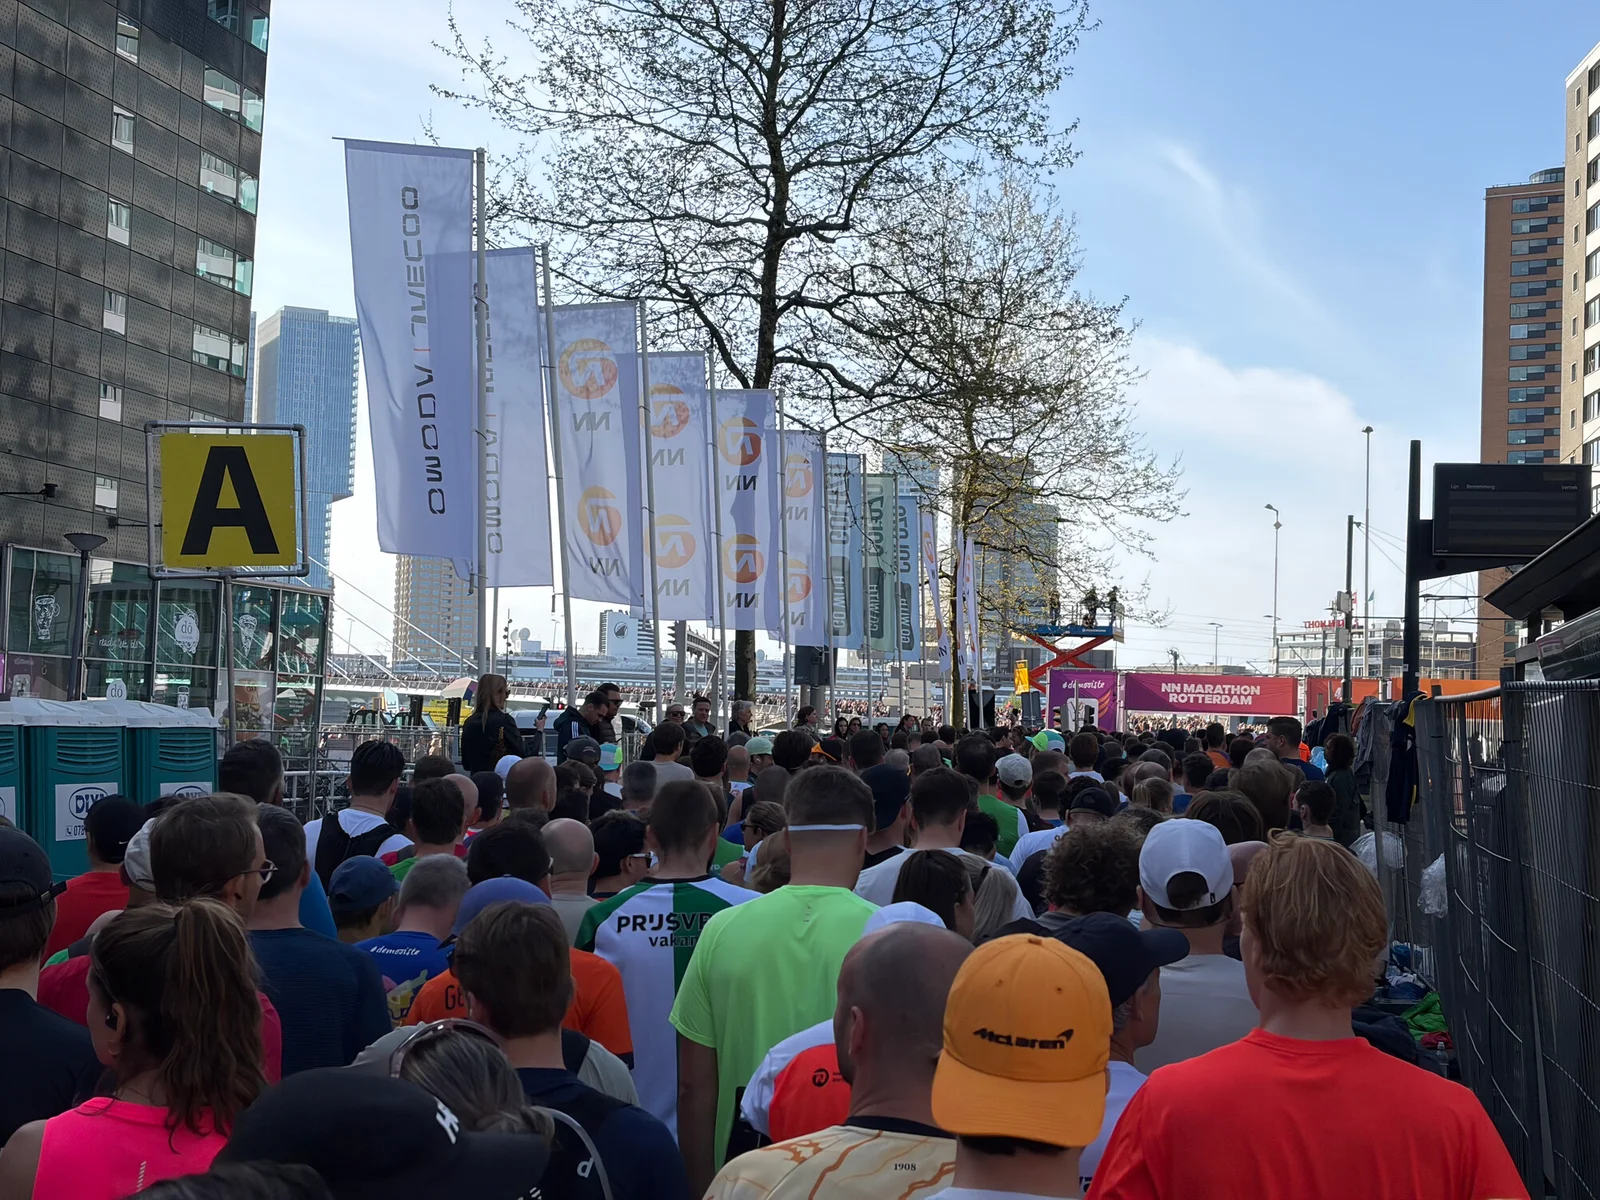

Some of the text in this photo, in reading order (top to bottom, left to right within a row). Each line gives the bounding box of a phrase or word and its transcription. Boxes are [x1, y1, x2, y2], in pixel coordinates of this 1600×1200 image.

[180, 446, 280, 555] A
[1161, 683, 1261, 696] NN MARATHON
[1169, 693, 1253, 705] ROTTERDAM
[973, 1028, 1065, 1049] McLaren
[894, 1163, 917, 1171] 1908
